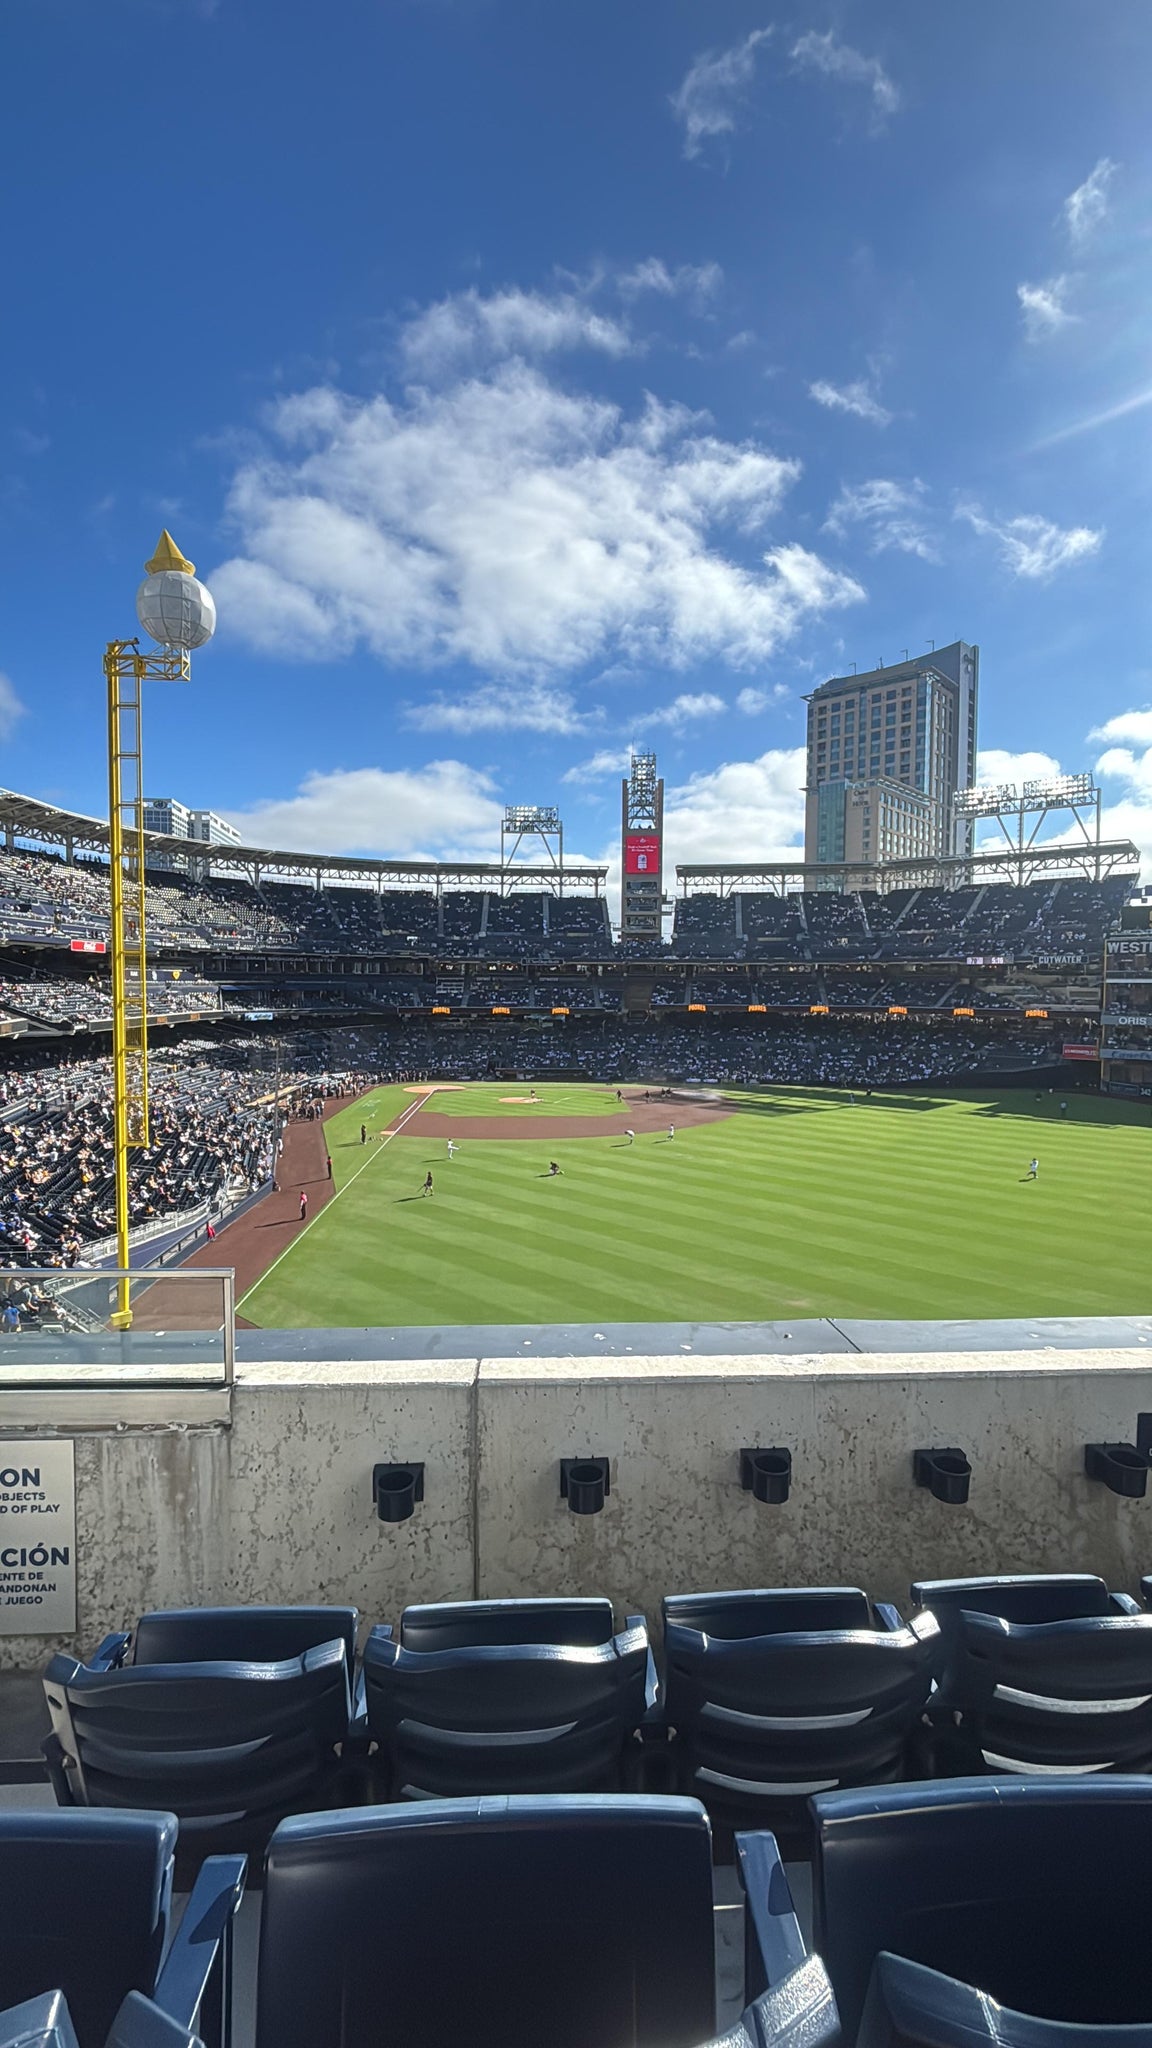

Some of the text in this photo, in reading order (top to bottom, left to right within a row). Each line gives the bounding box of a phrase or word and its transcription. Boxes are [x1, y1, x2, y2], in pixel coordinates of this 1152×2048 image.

[1107, 941, 1152, 953] WEST
[1038, 955, 1082, 964] CUTWATER
[1025, 1009, 1048, 1018] PADRES
[1118, 1016, 1147, 1025] ORIS
[0, 1468, 40, 1487] ON
[0, 1492, 46, 1501] BJECTS
[11, 1505, 28, 1514] OF
[30, 1504, 60, 1513] PLAY
[0, 1542, 70, 1567] CIÓN
[28, 1572, 44, 1580] DE
[5, 1596, 43, 1605] JUEGO
